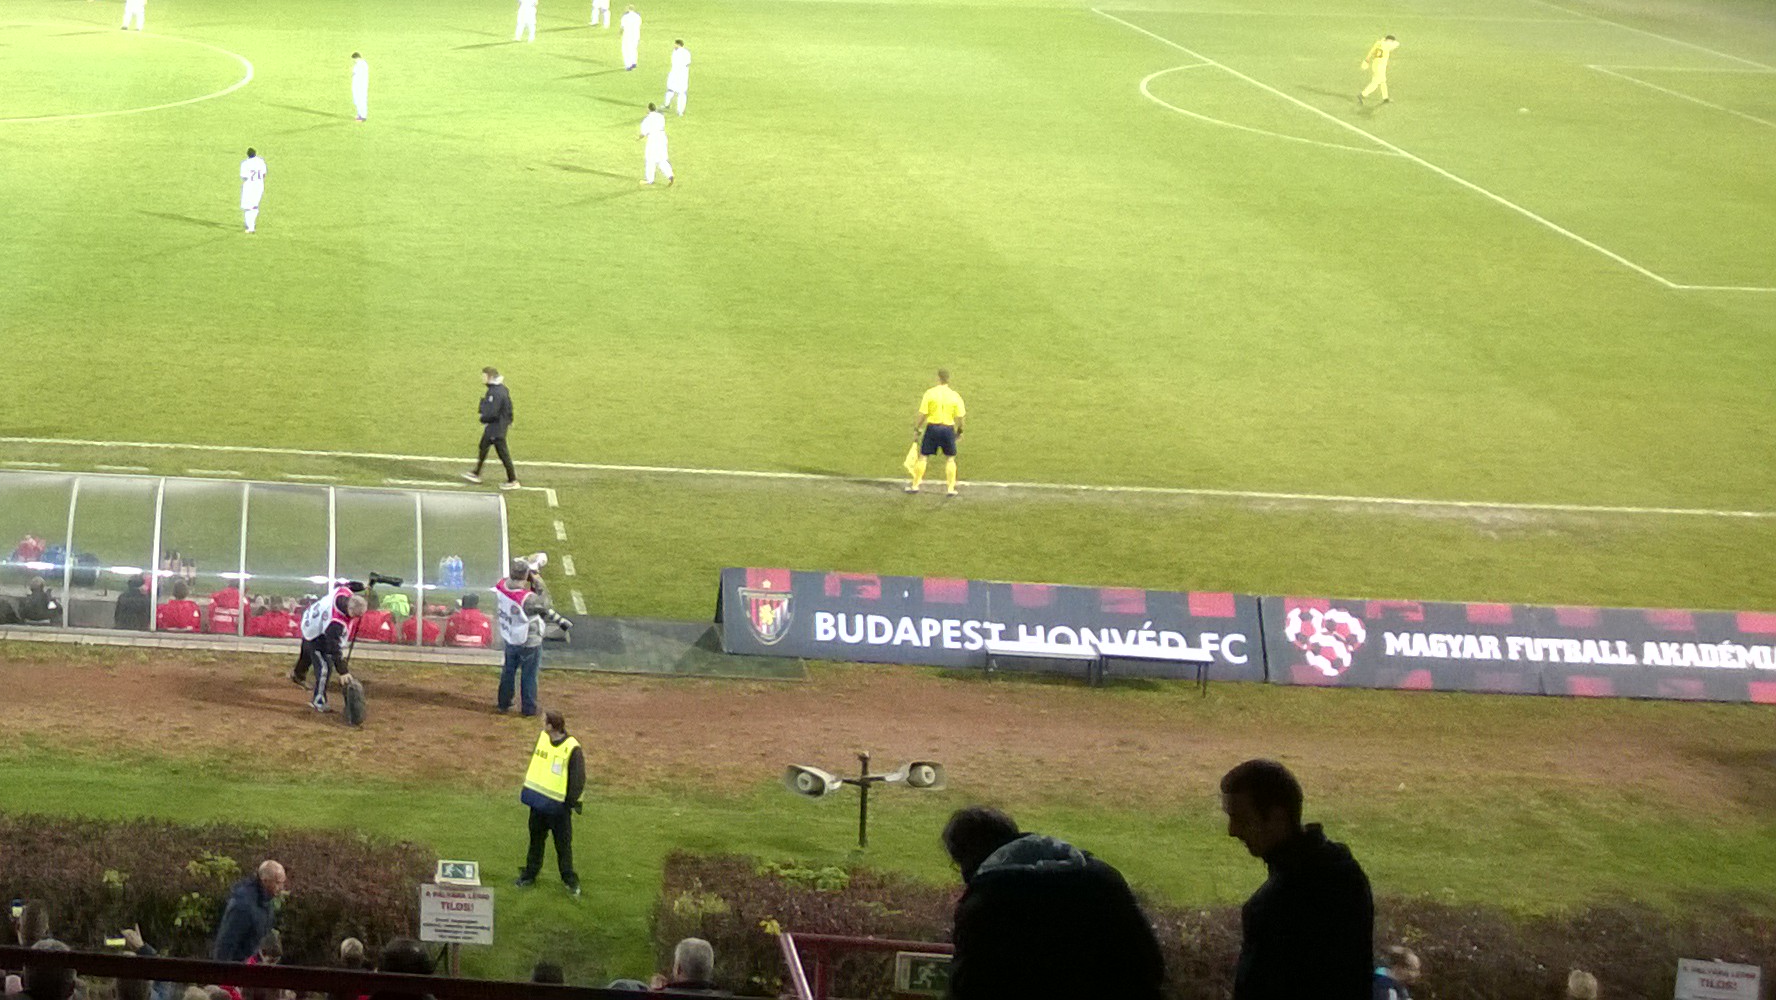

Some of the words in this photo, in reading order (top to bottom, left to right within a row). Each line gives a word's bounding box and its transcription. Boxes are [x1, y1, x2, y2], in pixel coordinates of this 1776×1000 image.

[815, 611, 1006, 651] BUDAPEST
[1200, 632, 1249, 665] FC
[1383, 631, 1503, 661] MAGYAR
[1505, 636, 1637, 666] FUTBALL
[1642, 640, 1776, 670] AKADÉMI
